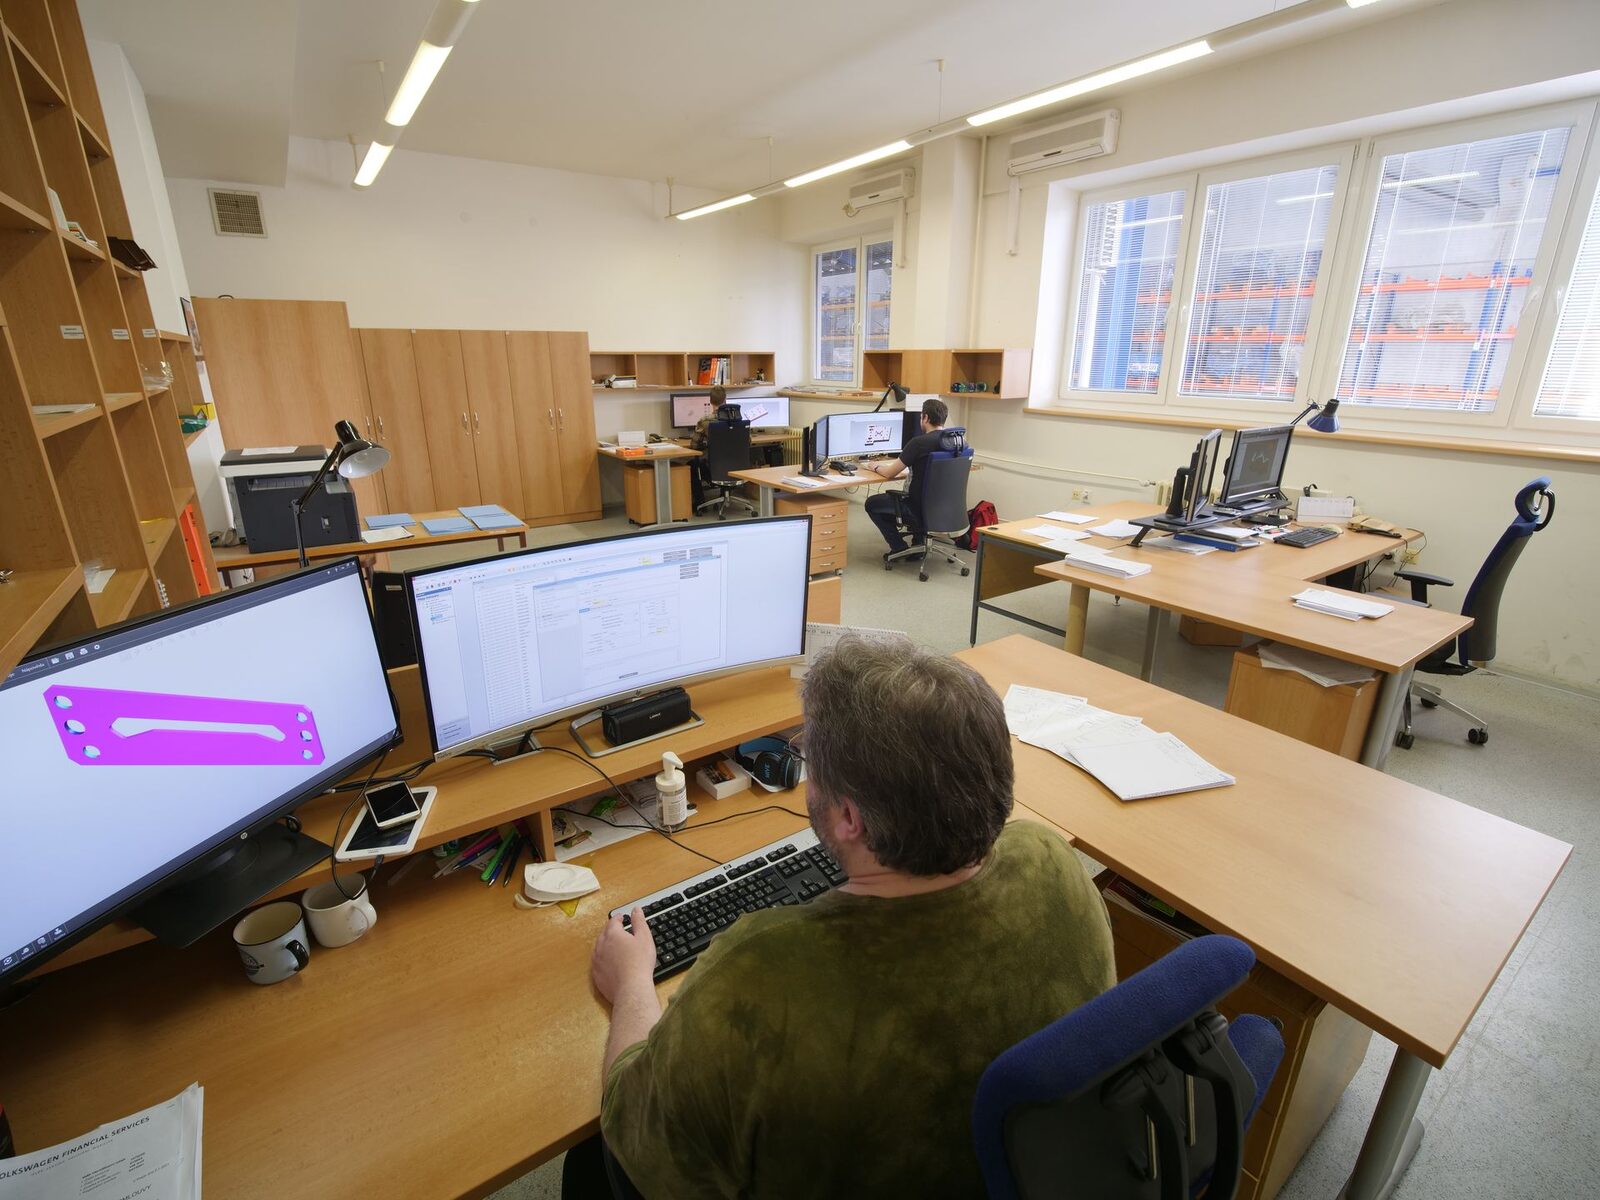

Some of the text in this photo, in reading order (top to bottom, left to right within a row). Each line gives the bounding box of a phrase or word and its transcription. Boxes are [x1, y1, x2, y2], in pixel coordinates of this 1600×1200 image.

[0, 1155, 59, 1179] OLKSWAGEN
[62, 1134, 109, 1157] FINANCIAL
[111, 1115, 150, 1136] SERVICES
